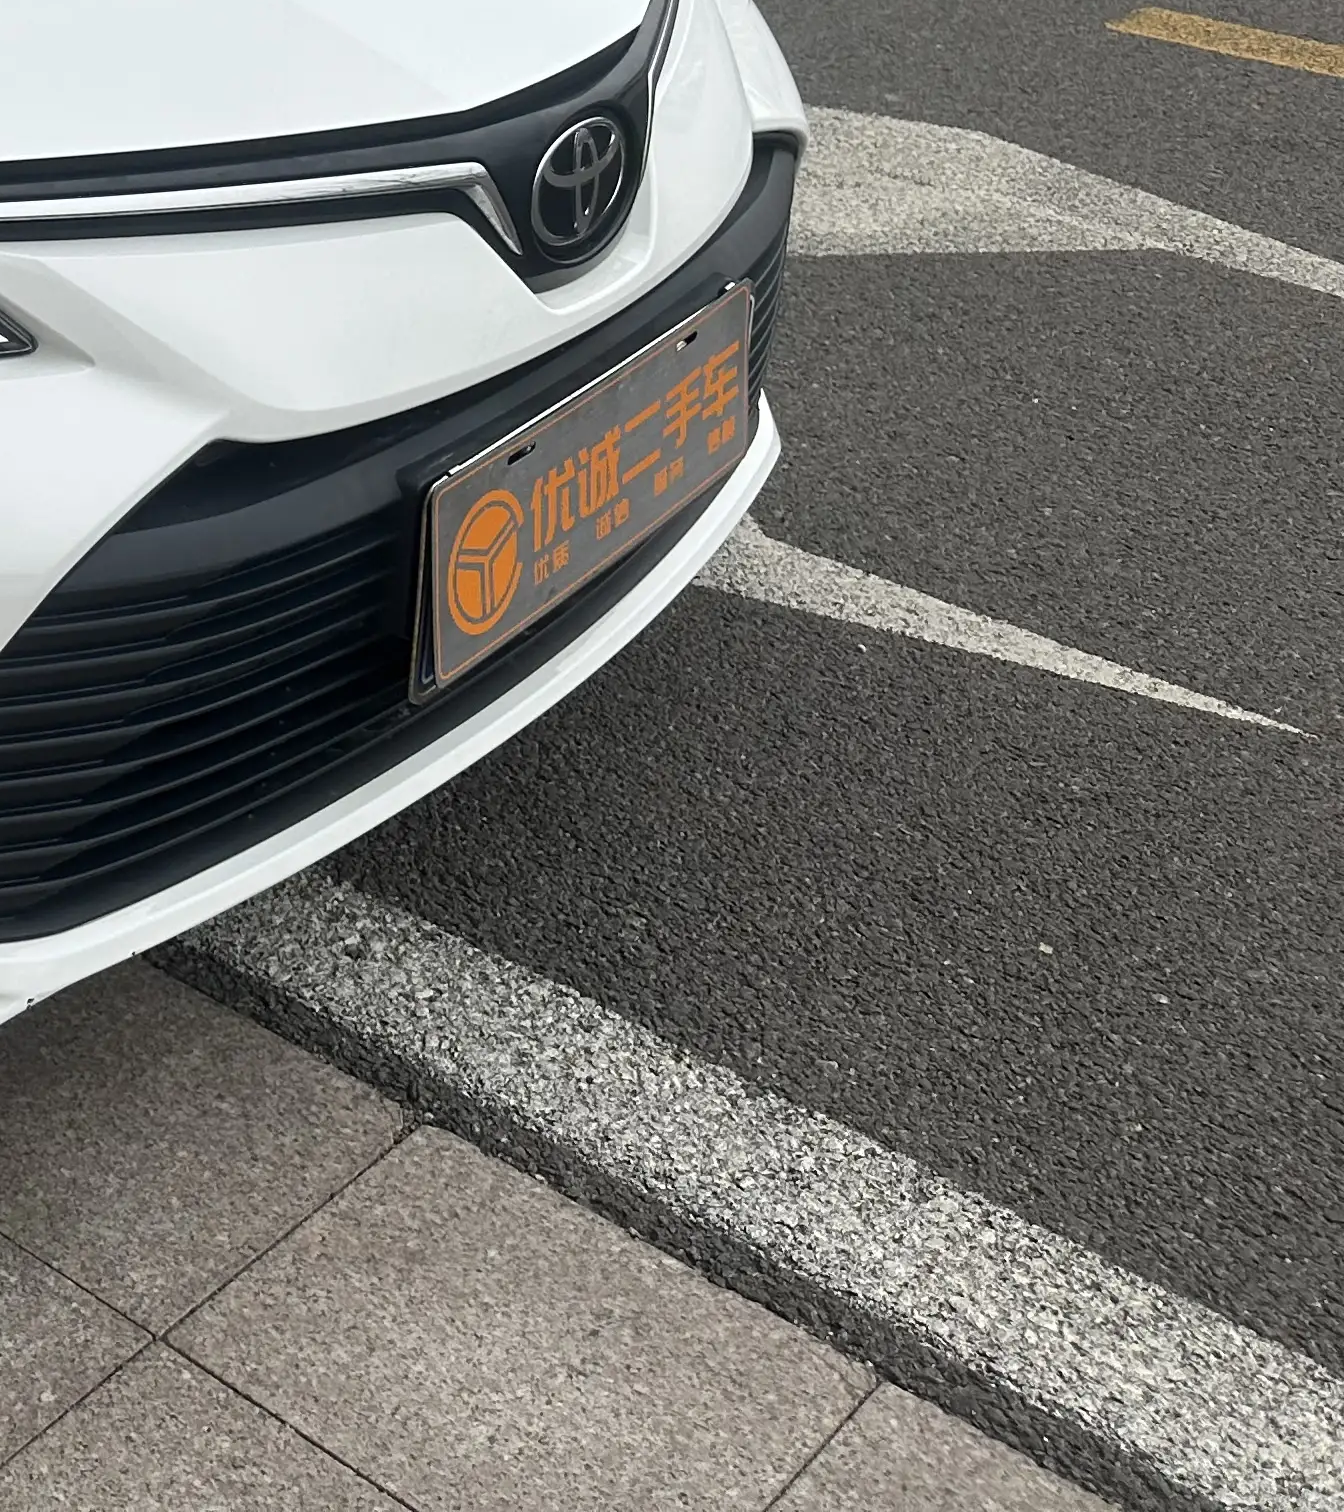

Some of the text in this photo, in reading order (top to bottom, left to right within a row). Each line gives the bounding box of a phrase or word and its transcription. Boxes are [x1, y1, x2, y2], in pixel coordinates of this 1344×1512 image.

[530, 340, 741, 552] 优诚二手车
